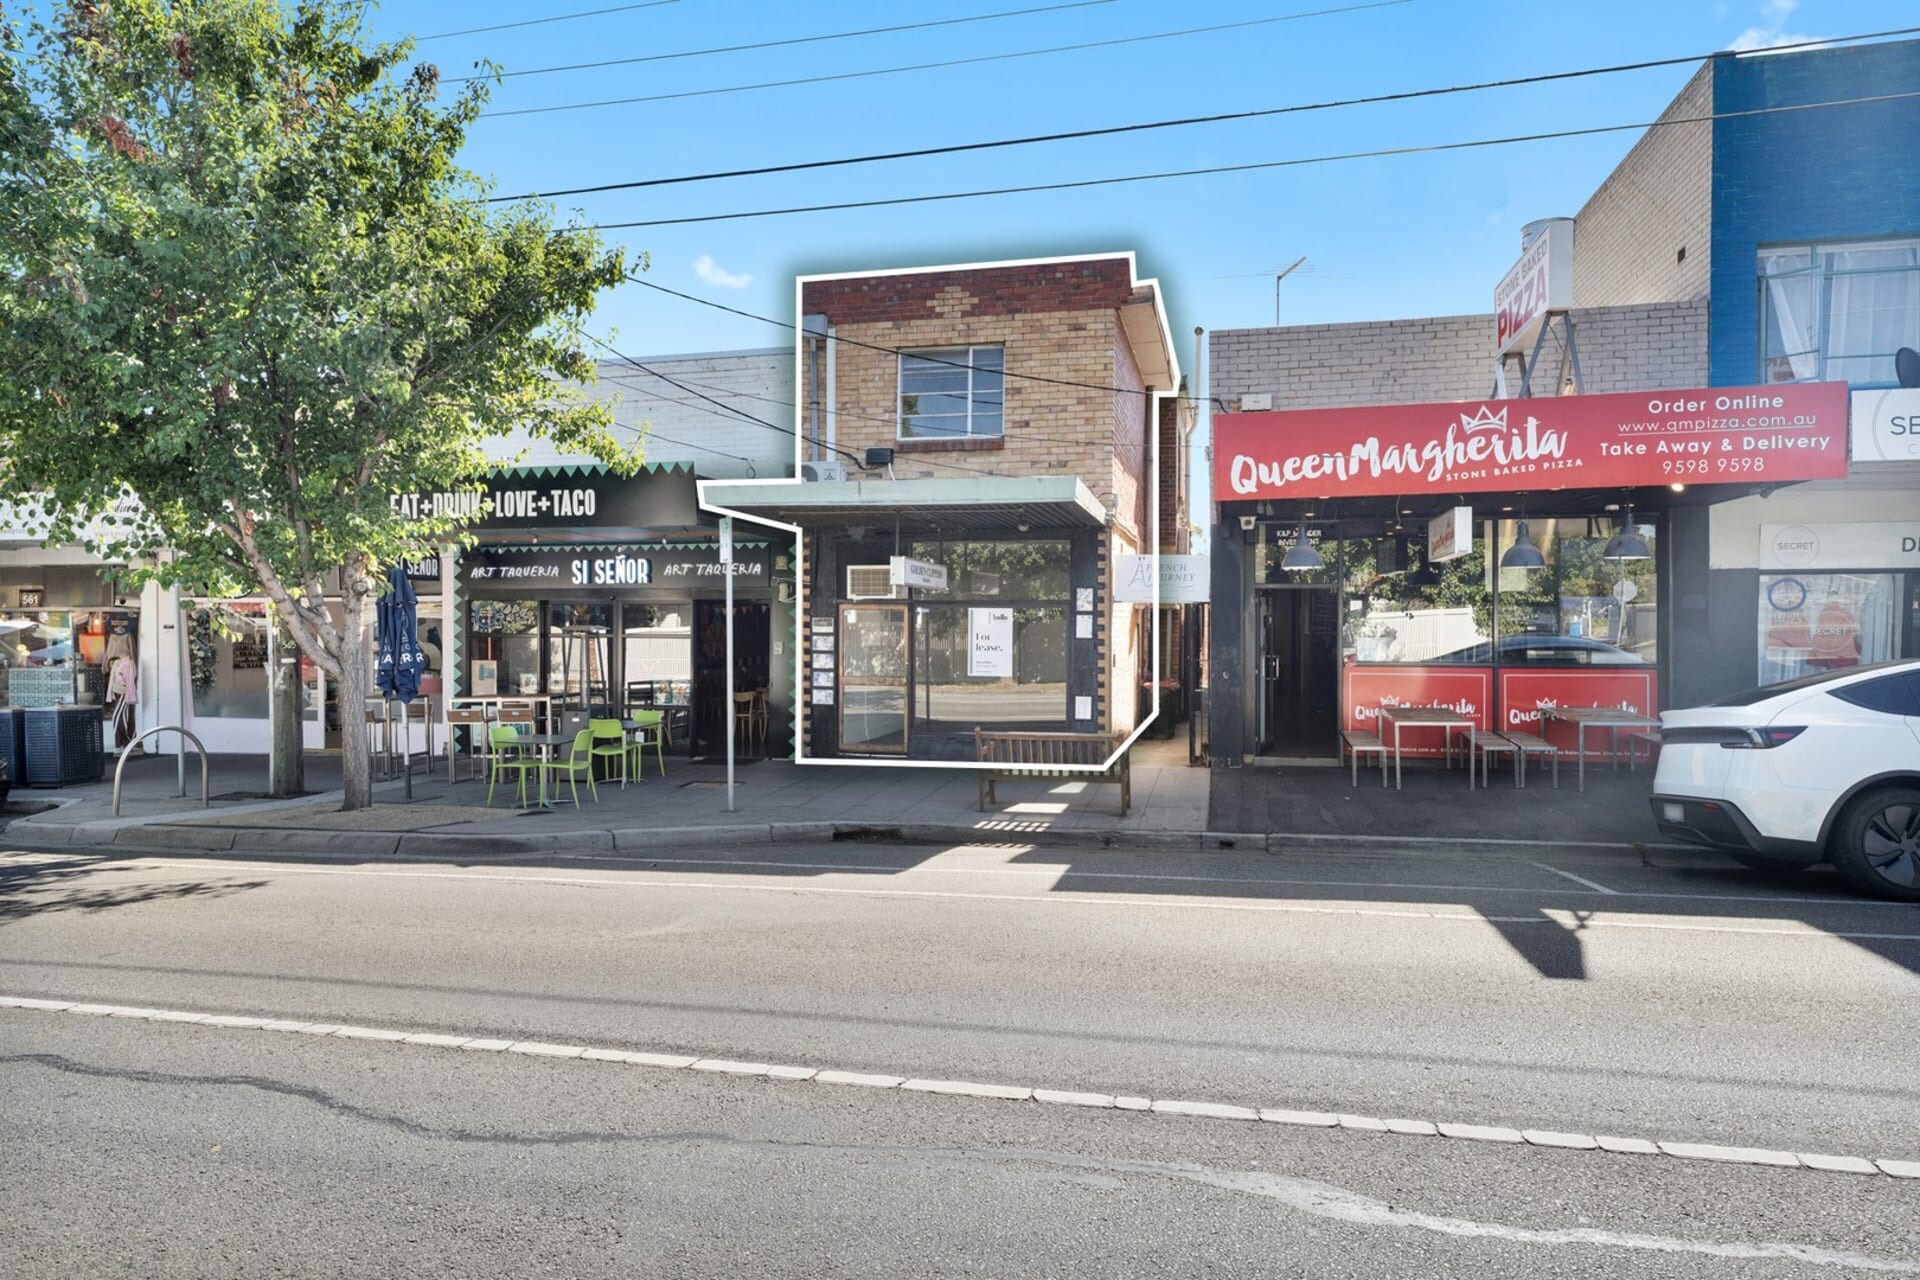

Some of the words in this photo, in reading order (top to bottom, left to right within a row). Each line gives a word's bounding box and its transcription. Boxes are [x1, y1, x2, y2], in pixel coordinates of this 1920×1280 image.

[1521, 239, 1547, 280] BAKED
[1498, 264, 1546, 349] PIZZA
[1648, 399, 1707, 414] Order
[1715, 395, 1784, 411] Online
[1618, 414, 1816, 433] www.qmpizza.com.au
[1600, 441, 1648, 456] Take
[1656, 439, 1712, 455] Away
[1721, 438, 1733, 451] &
[1743, 435, 1831, 450] Delivery
[1446, 469, 1487, 482] STONE
[1494, 465, 1536, 477] BAKED
[1543, 458, 1584, 470] PIZZA
[1662, 460, 1709, 475] 9598
[1717, 457, 1764, 472] 9598
[1777, 542, 1814, 551] SECRET
[1902, 537, 1920, 552] D
[471, 567, 498, 578] ART
[499, 565, 559, 578] TAQUERIA
[572, 559, 588, 585] SI
[594, 555, 650, 584] SEÑOR
[664, 564, 694, 576] ART
[976, 632, 991, 641] For
[975, 643, 1004, 652] lease.
